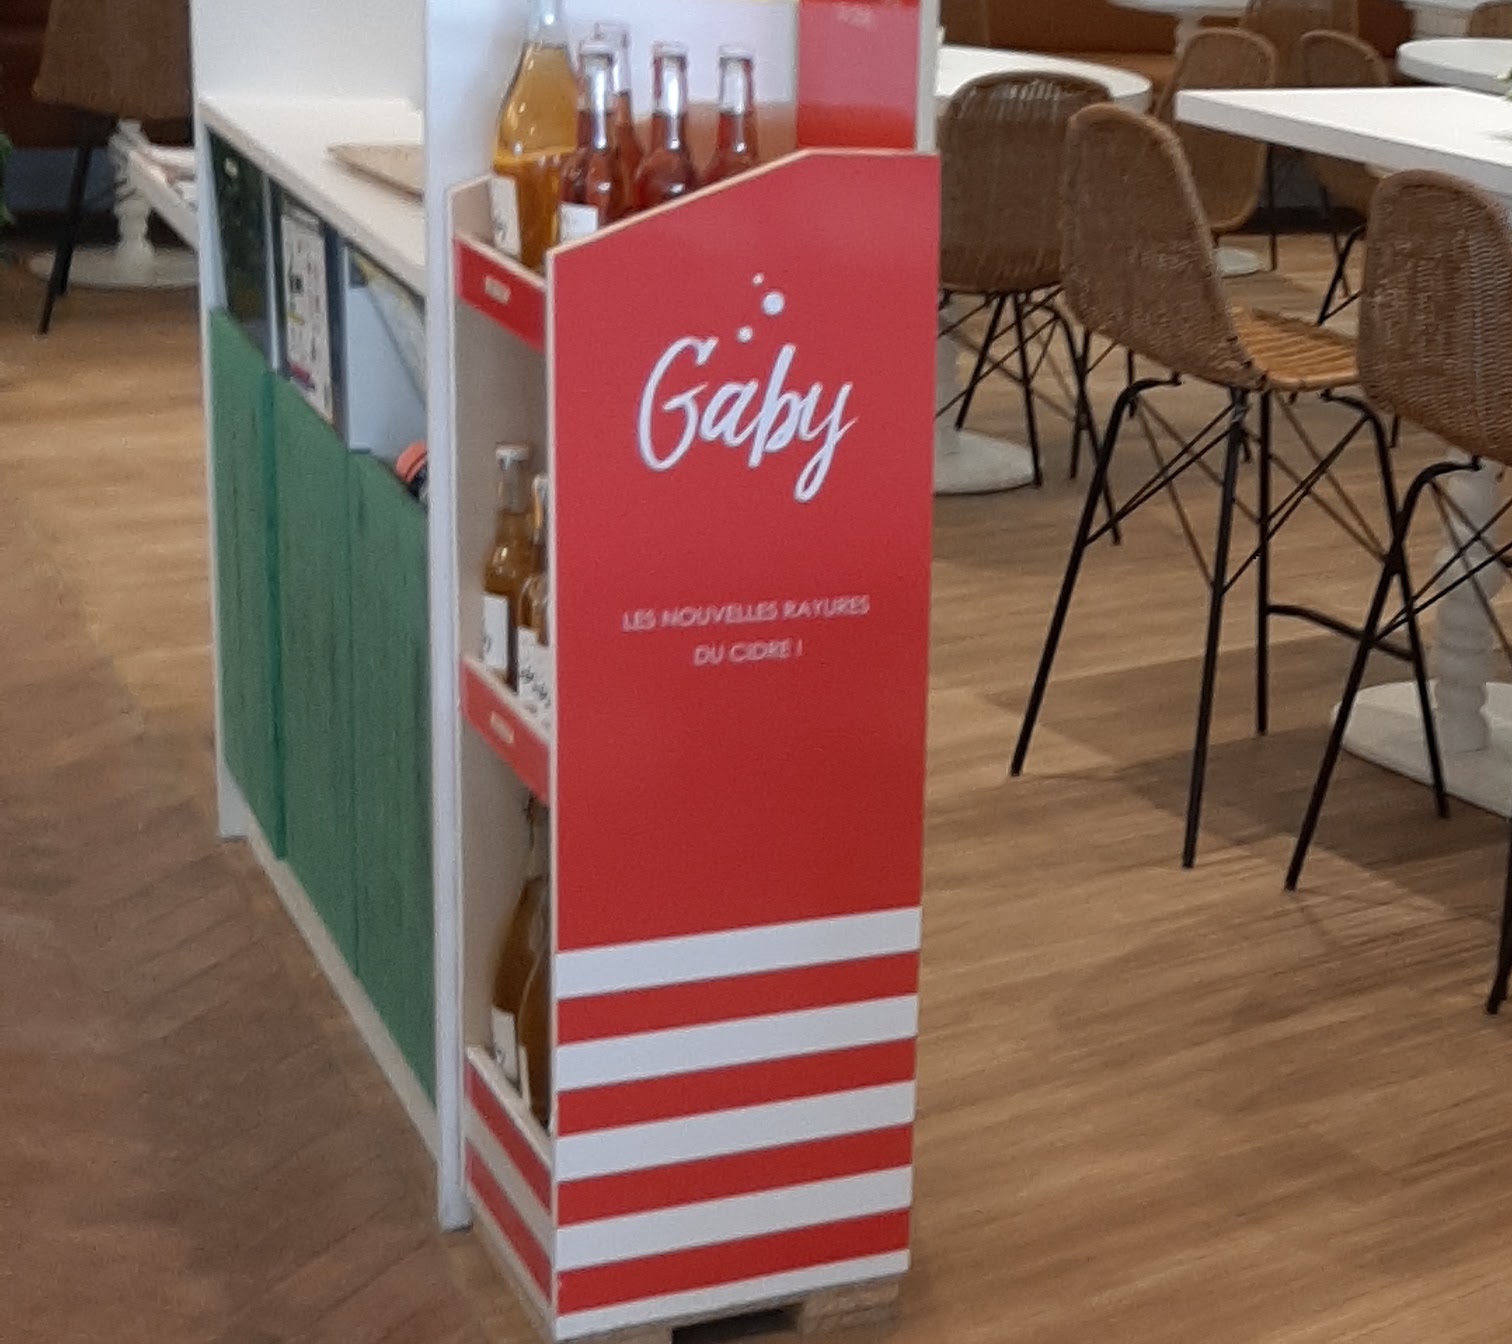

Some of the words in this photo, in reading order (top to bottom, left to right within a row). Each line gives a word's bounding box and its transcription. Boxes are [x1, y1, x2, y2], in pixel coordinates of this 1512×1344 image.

[636, 335, 860, 504] Gaby
[622, 608, 657, 632] LES
[660, 600, 778, 627] NOUVELLES
[781, 594, 870, 619] RAYURES
[693, 644, 724, 666] DU
[728, 637, 791, 662] CIDRE
